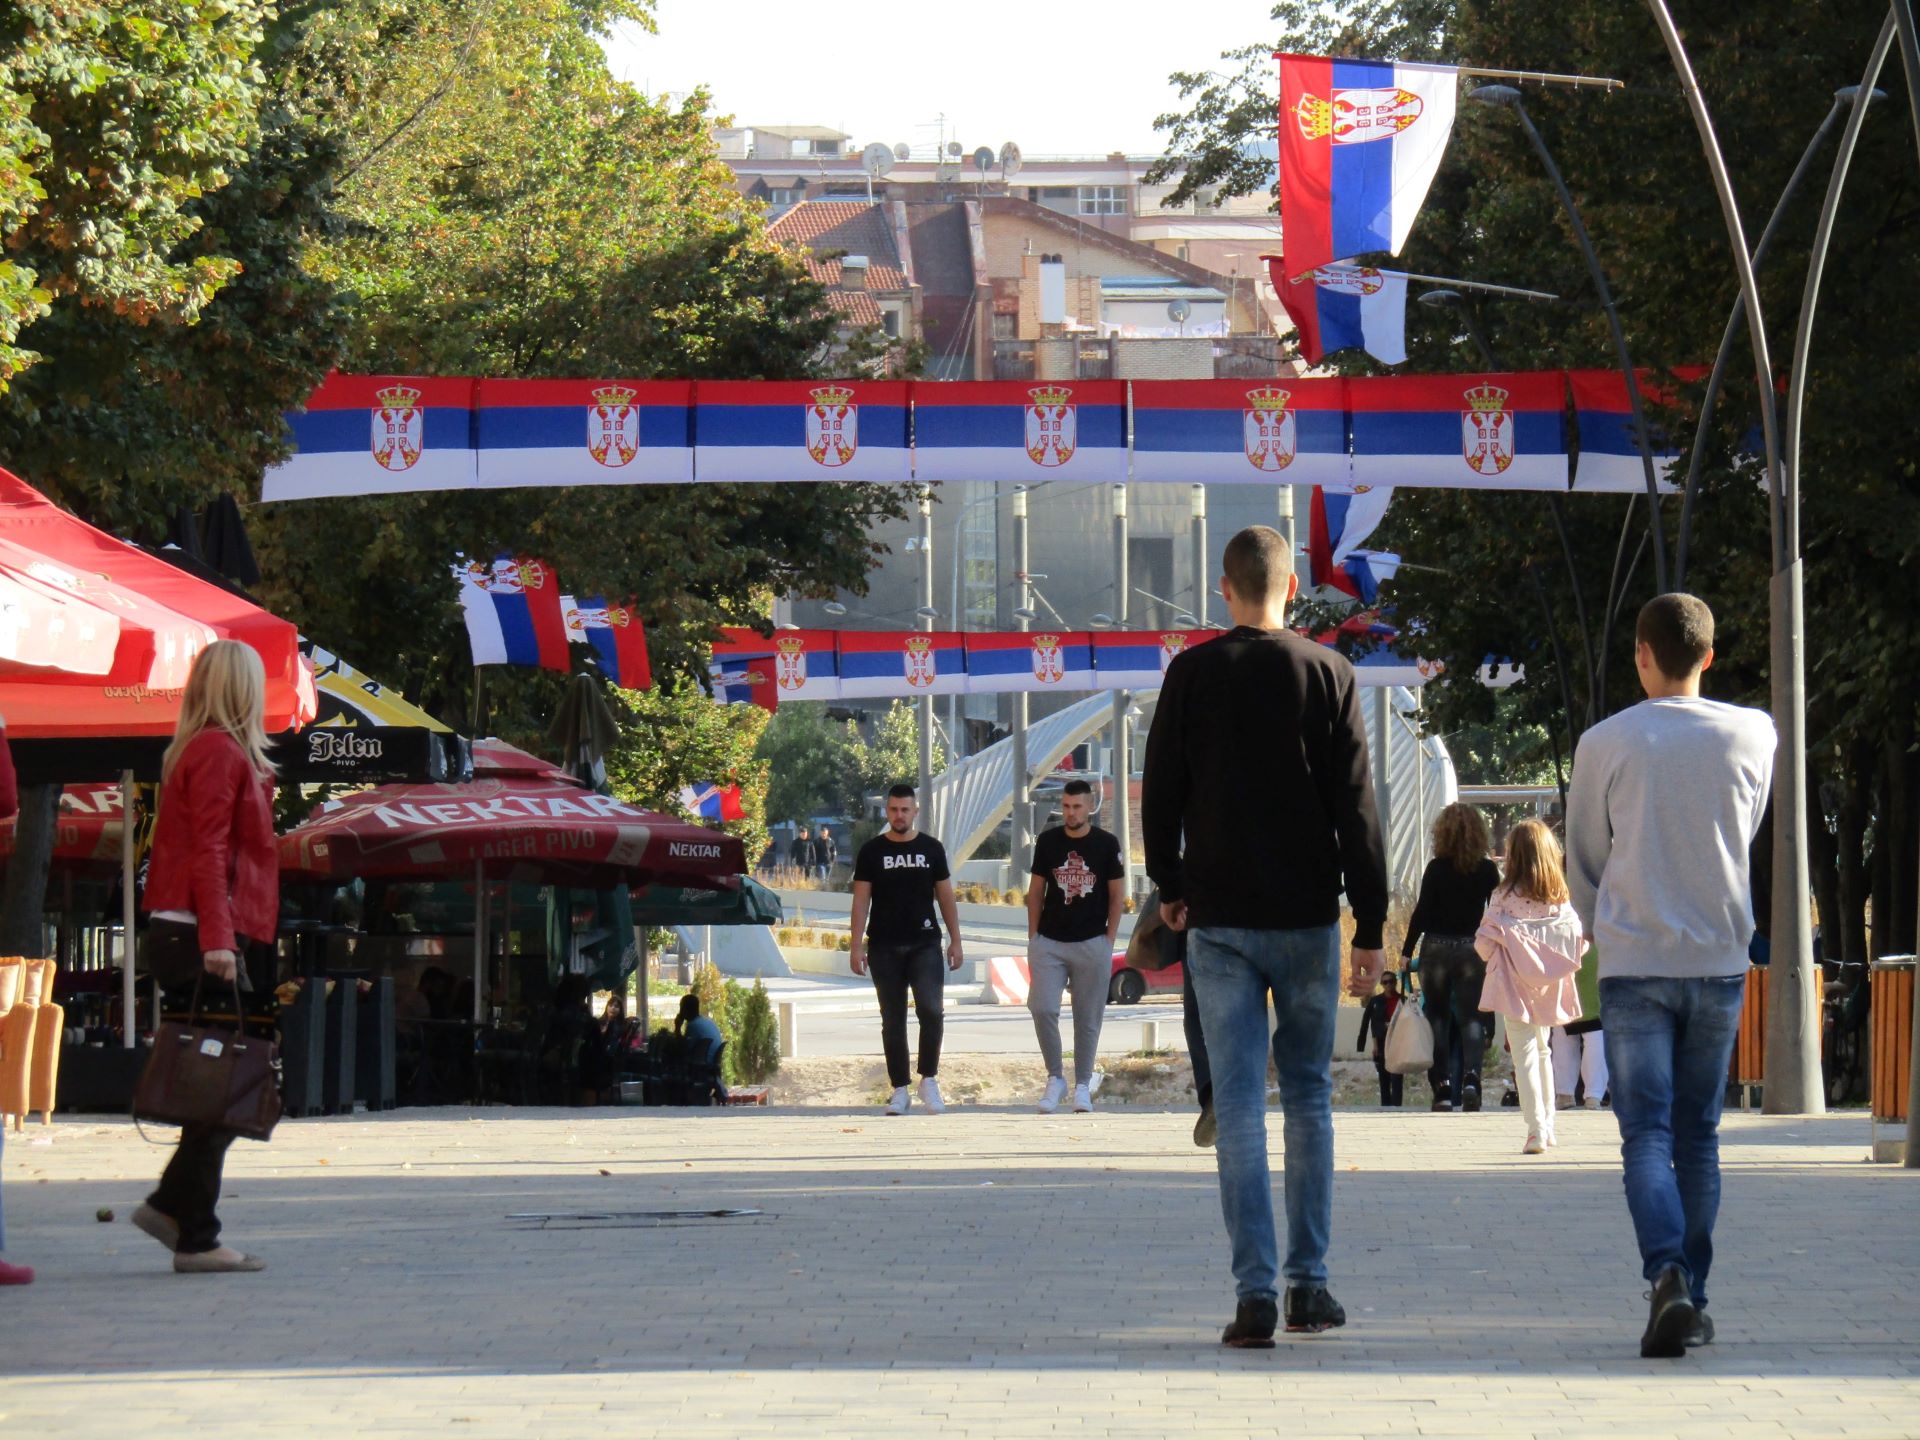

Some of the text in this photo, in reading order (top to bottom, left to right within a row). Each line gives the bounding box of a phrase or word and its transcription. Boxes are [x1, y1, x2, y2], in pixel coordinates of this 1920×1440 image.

[308, 731, 383, 763] Jelen
[374, 795, 646, 828] NEKTAR
[546, 828, 595, 851] PIVO
[669, 843, 721, 858] NEKTAR
[883, 854, 930, 869] BALR.
